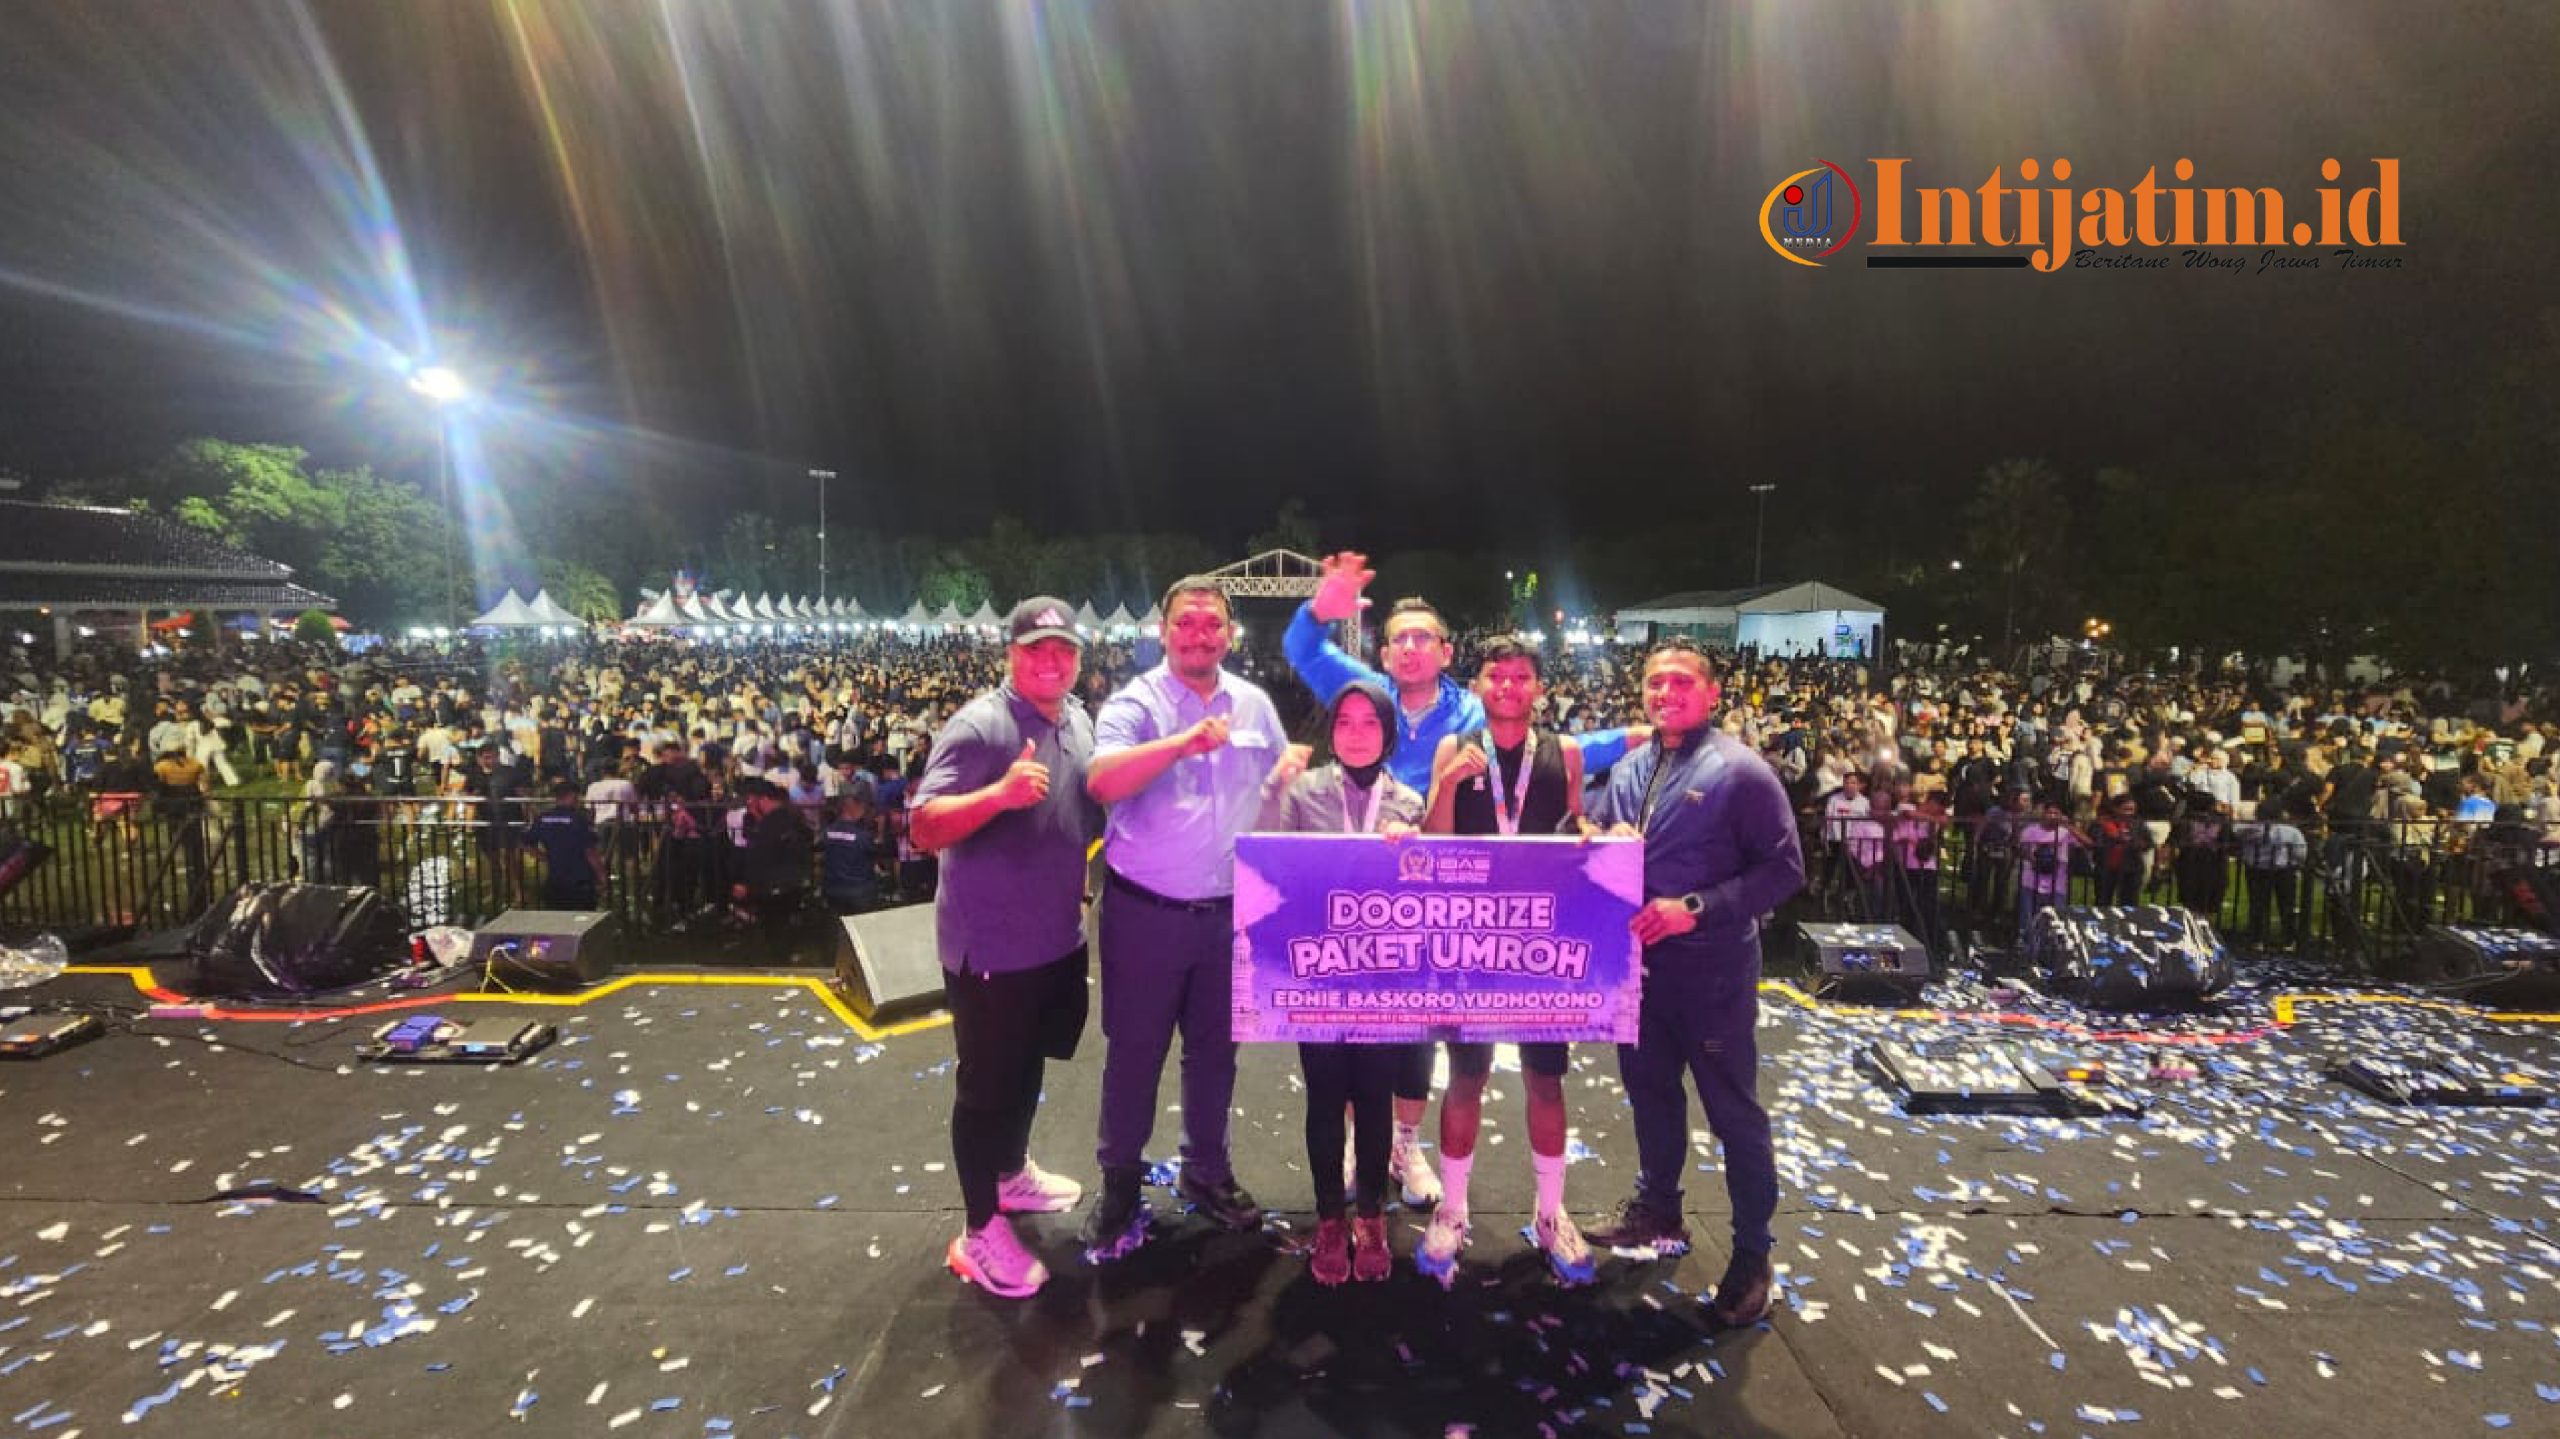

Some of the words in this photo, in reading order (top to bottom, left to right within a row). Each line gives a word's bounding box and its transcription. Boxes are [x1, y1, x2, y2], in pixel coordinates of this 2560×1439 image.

[1331, 892, 1553, 929] DOORPRIZE
[1291, 931, 1424, 977] PAKET
[1430, 931, 1588, 980] UMROH
[1274, 989, 1343, 1008] EDHIE
[1347, 991, 1457, 1008] BASKORO
